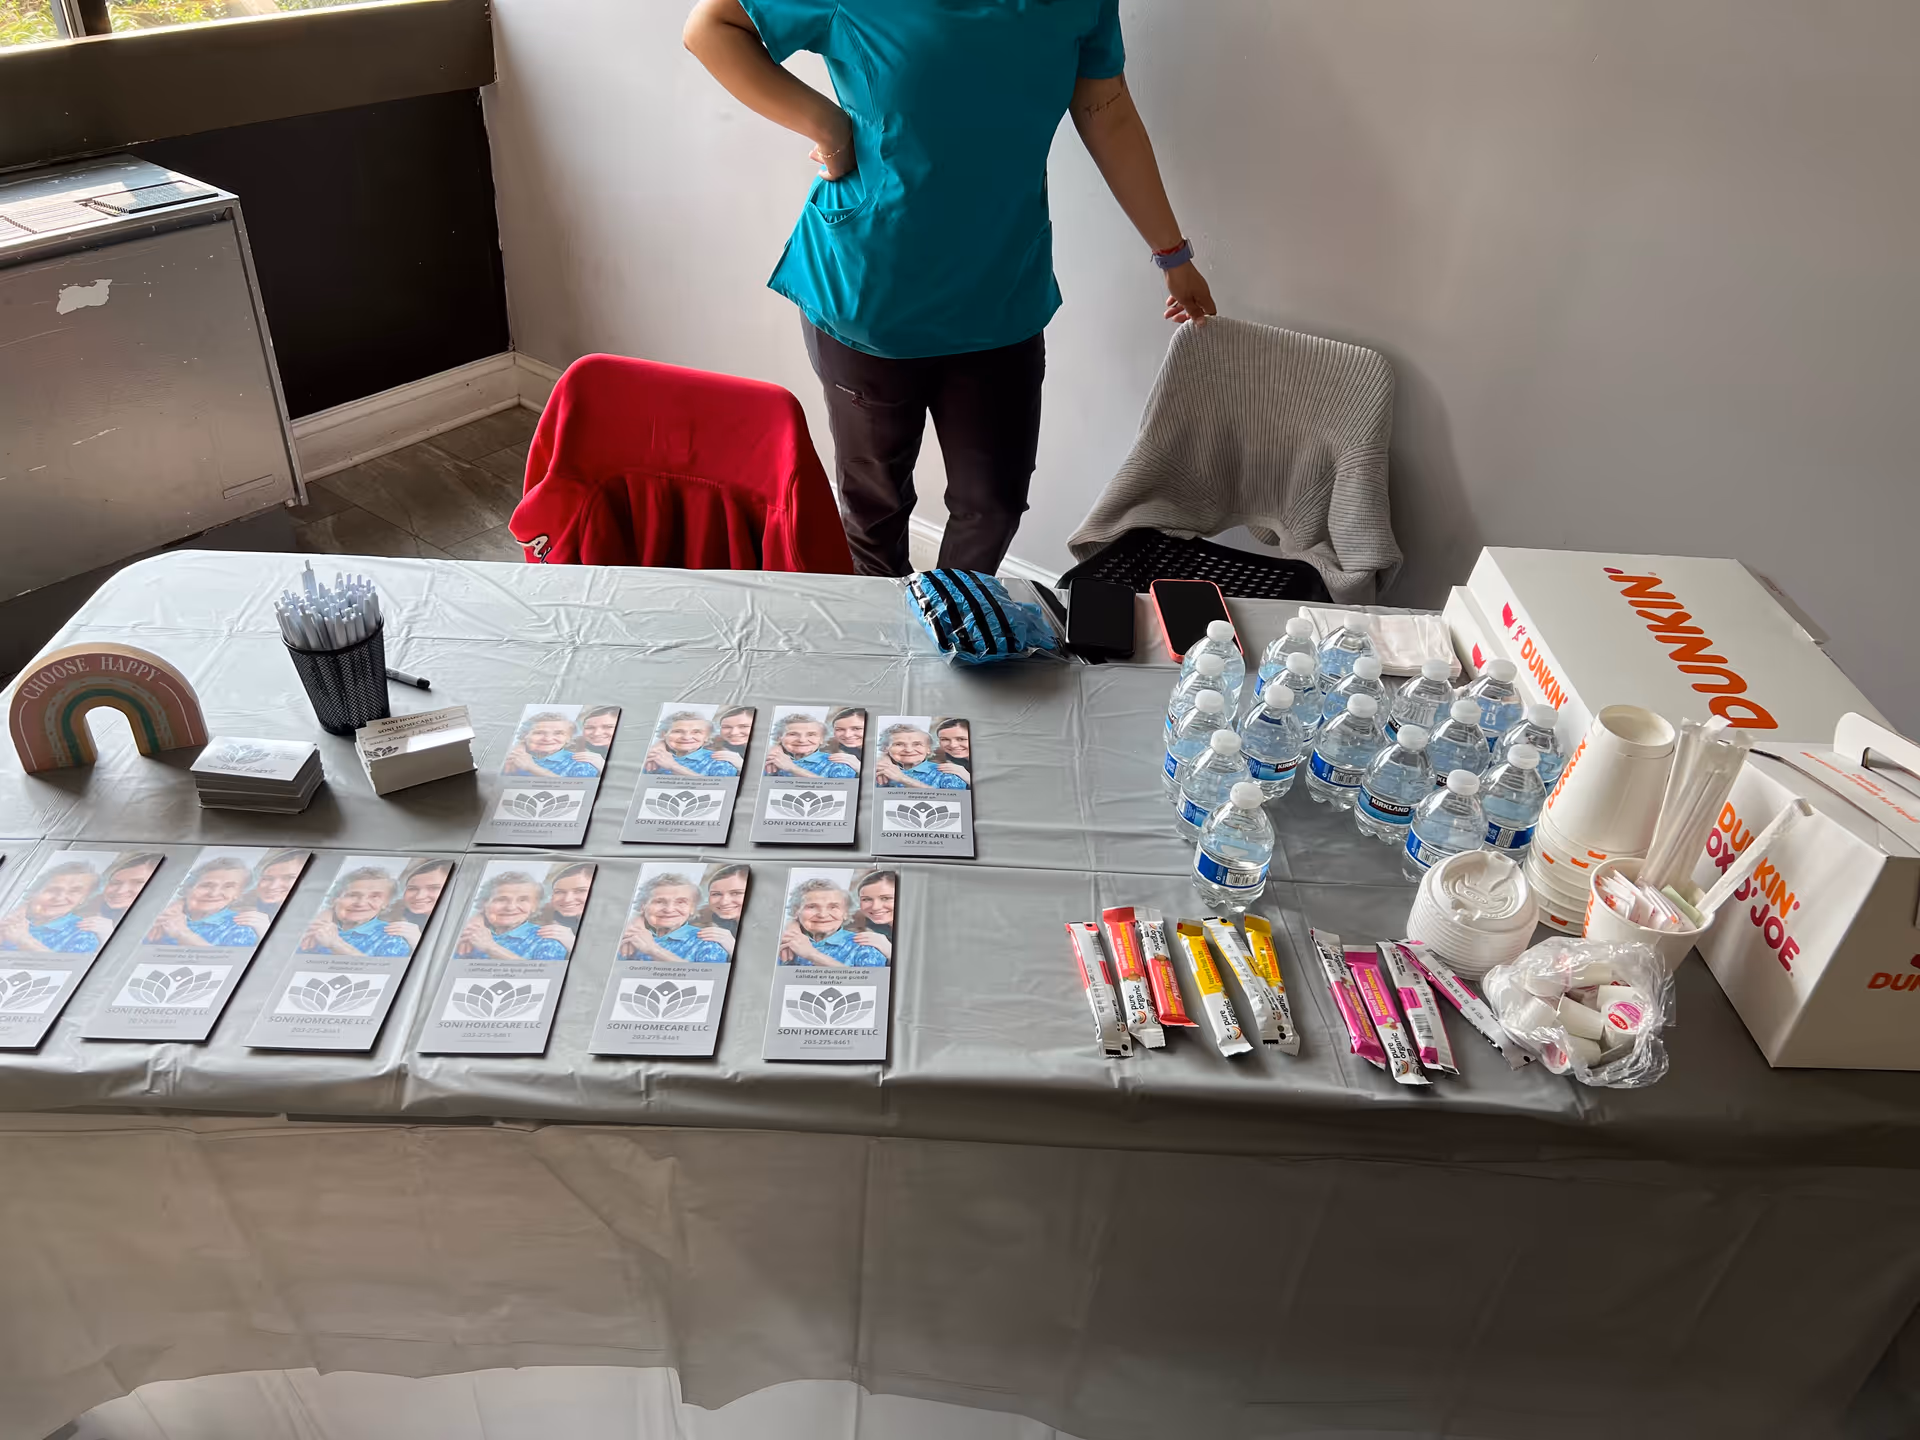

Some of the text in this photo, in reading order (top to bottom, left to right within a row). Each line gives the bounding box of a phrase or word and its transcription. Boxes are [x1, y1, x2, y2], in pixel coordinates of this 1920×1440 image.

[1603, 567, 1779, 730] DUNKIN'
[22, 656, 161, 700] CHOOSE HAPPY
[1520, 637, 1568, 711] DUNKIN'
[1371, 797, 1410, 814] KIRKLAND
[1717, 801, 1800, 919] DUKIN'
[1705, 827, 1736, 876] OX
[1750, 903, 1800, 972] JOE
[1150, 929, 1162, 951] organic
[1157, 930, 1165, 944] pure
[1128, 994, 1137, 1010] pure
[1133, 984, 1145, 1010] organic
[296, 1016, 353, 1025] HOMECARE
[465, 1021, 521, 1029] HOMECARE
[1219, 1010, 1231, 1026] pure
[634, 1023, 690, 1031] HOMECARE
[804, 1028, 859, 1036] HOMECARE
[1388, 1042, 1400, 1059] pure
[1391, 1032, 1406, 1059] organic
